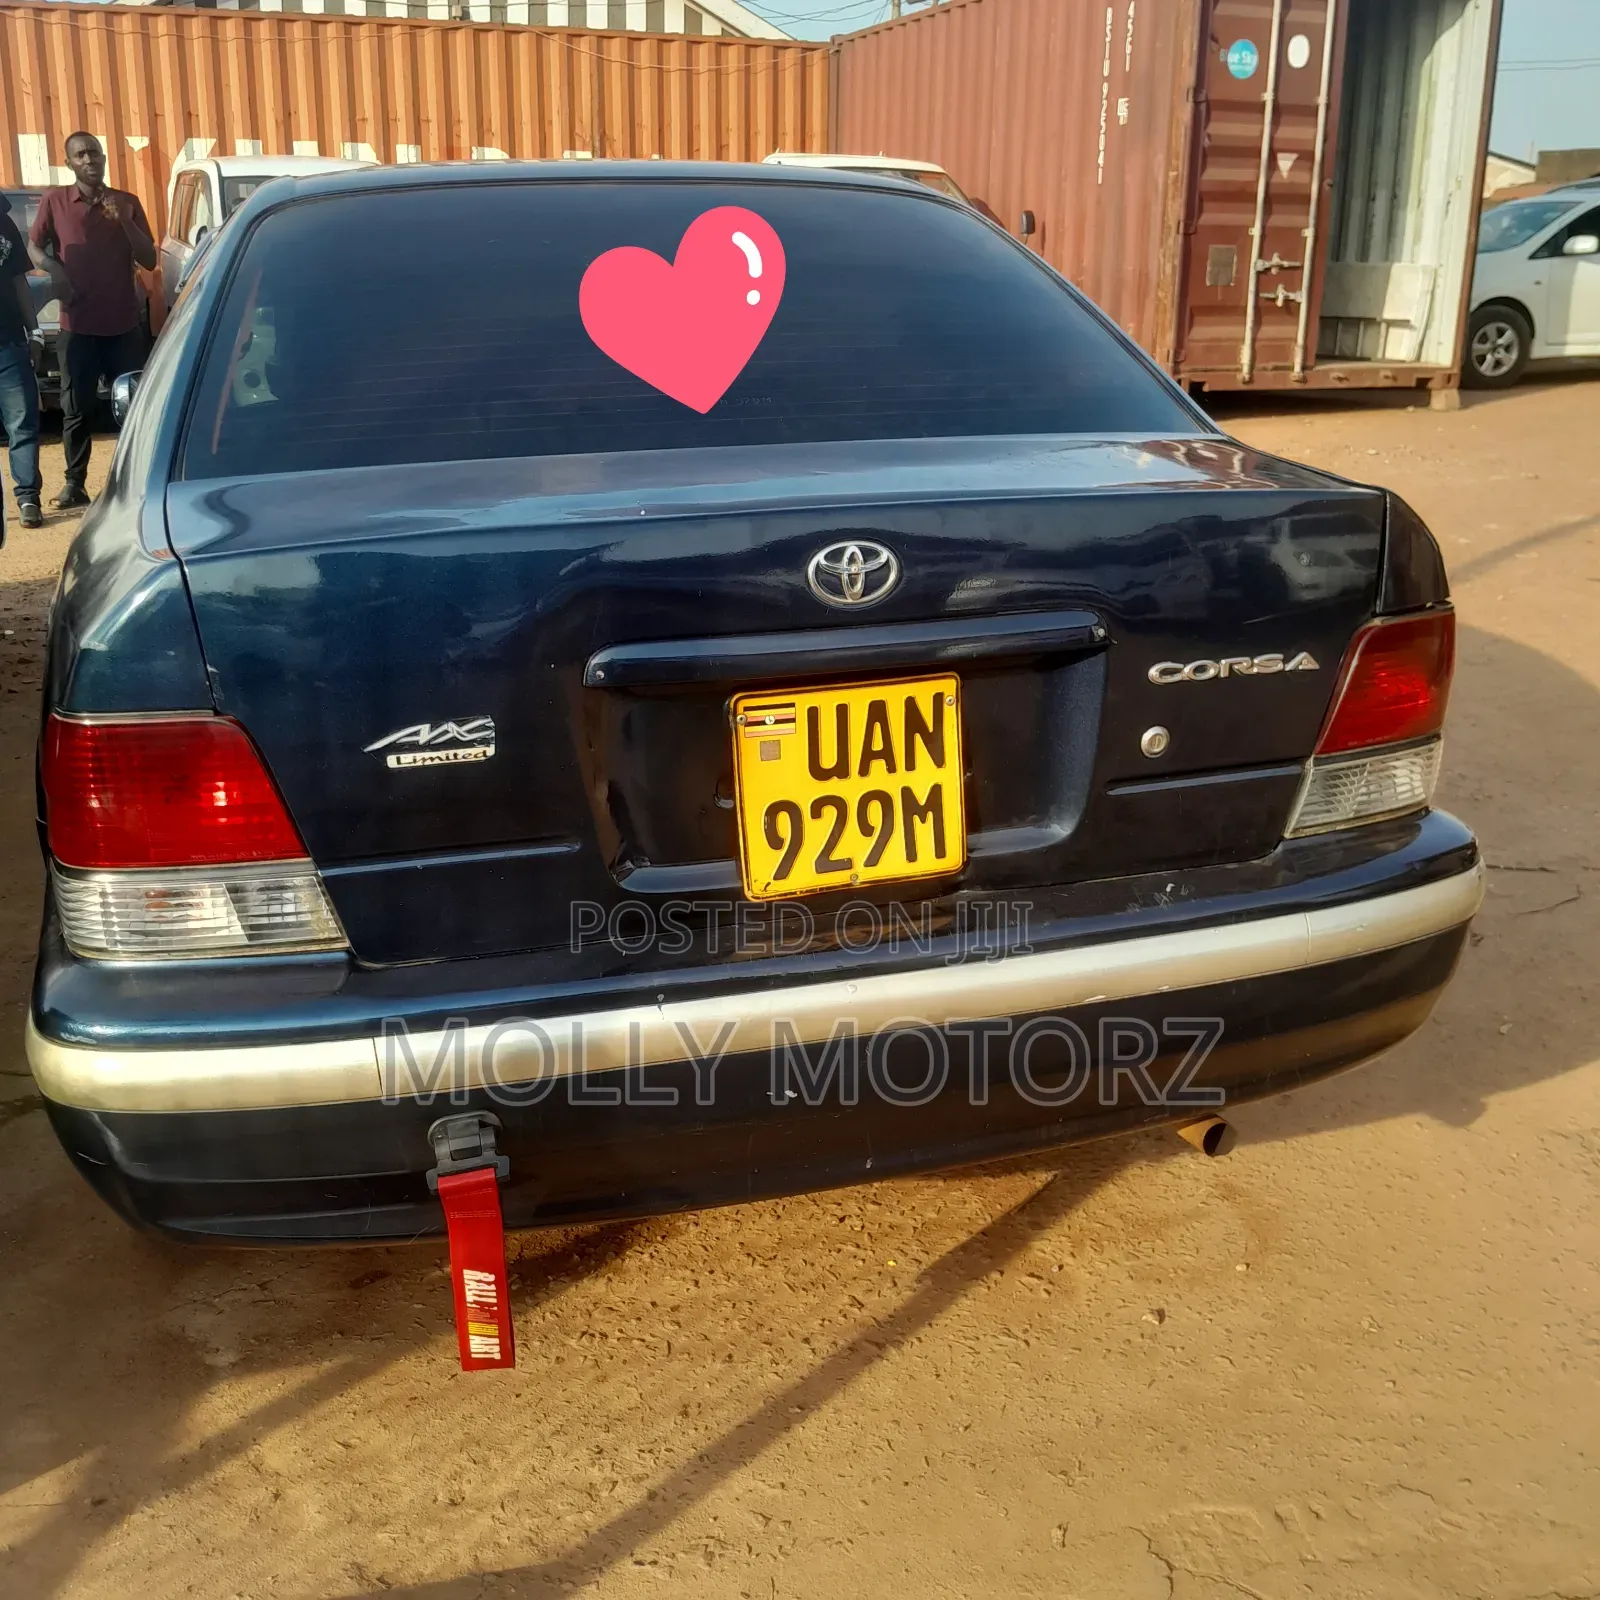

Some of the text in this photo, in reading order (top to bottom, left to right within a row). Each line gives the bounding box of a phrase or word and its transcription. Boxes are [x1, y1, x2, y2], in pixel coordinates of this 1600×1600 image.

[1147, 651, 1321, 685] CORSA
[396, 749, 489, 766] Limited
[806, 691, 947, 782] UAN
[763, 783, 947, 881] 929M
